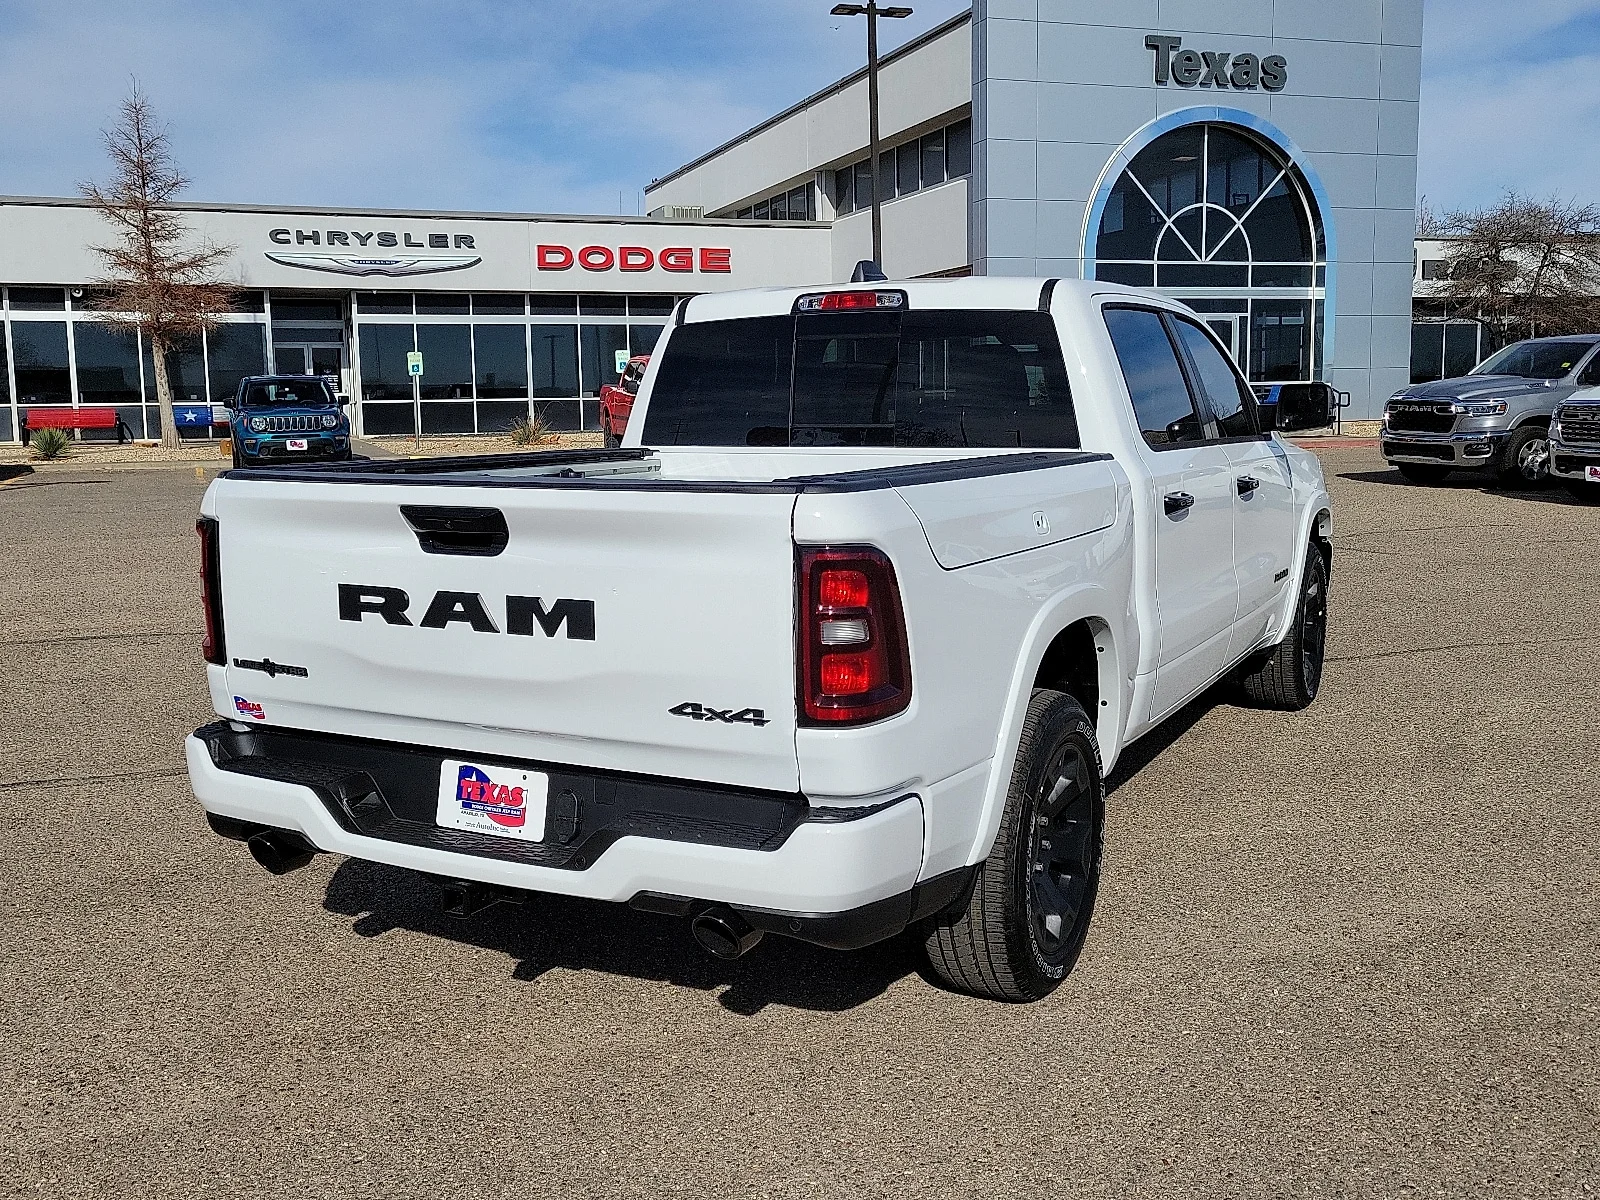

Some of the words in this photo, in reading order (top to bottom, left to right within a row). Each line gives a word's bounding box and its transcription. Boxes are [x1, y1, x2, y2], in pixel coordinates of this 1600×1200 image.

[1144, 34, 1288, 92] Texas
[268, 228, 477, 249] CHRYSLER
[536, 244, 732, 274] DODGE
[337, 582, 596, 642] RAM
[460, 778, 524, 807] TEXAS
